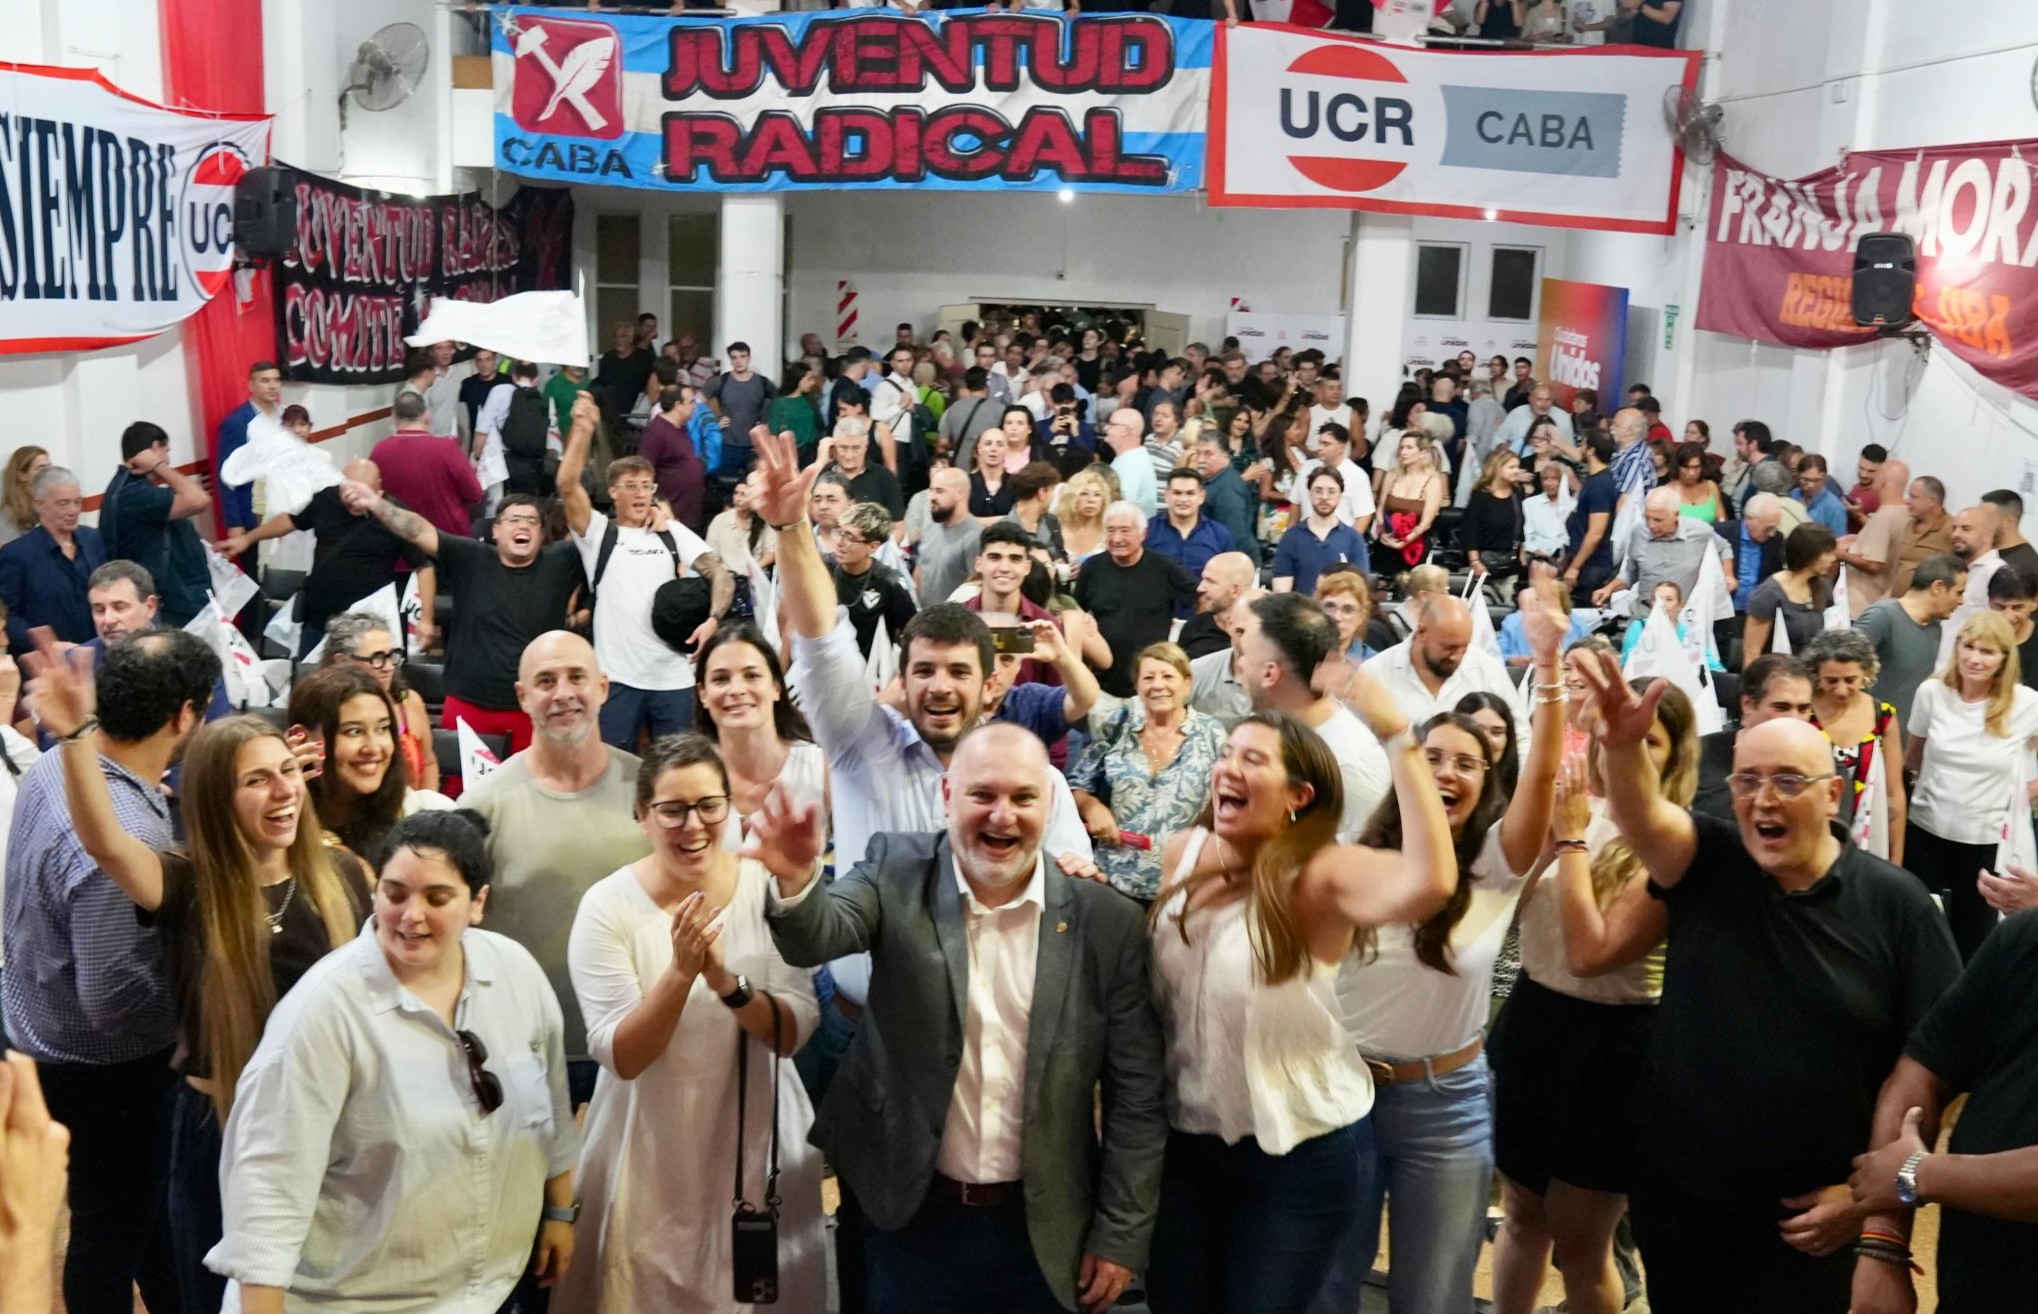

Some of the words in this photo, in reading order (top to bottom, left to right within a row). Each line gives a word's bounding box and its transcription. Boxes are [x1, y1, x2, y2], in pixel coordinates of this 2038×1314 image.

[661, 13, 1175, 100] JUVENTUD
[661, 103, 1173, 186] RADICAL
[1280, 88, 1414, 146] UCR
[1476, 111, 1594, 150] CABA
[502, 137, 634, 179] CABA
[189, 201, 235, 254] UC
[1716, 166, 1884, 254] FRANJA
[1549, 344, 1601, 391] Unidos
